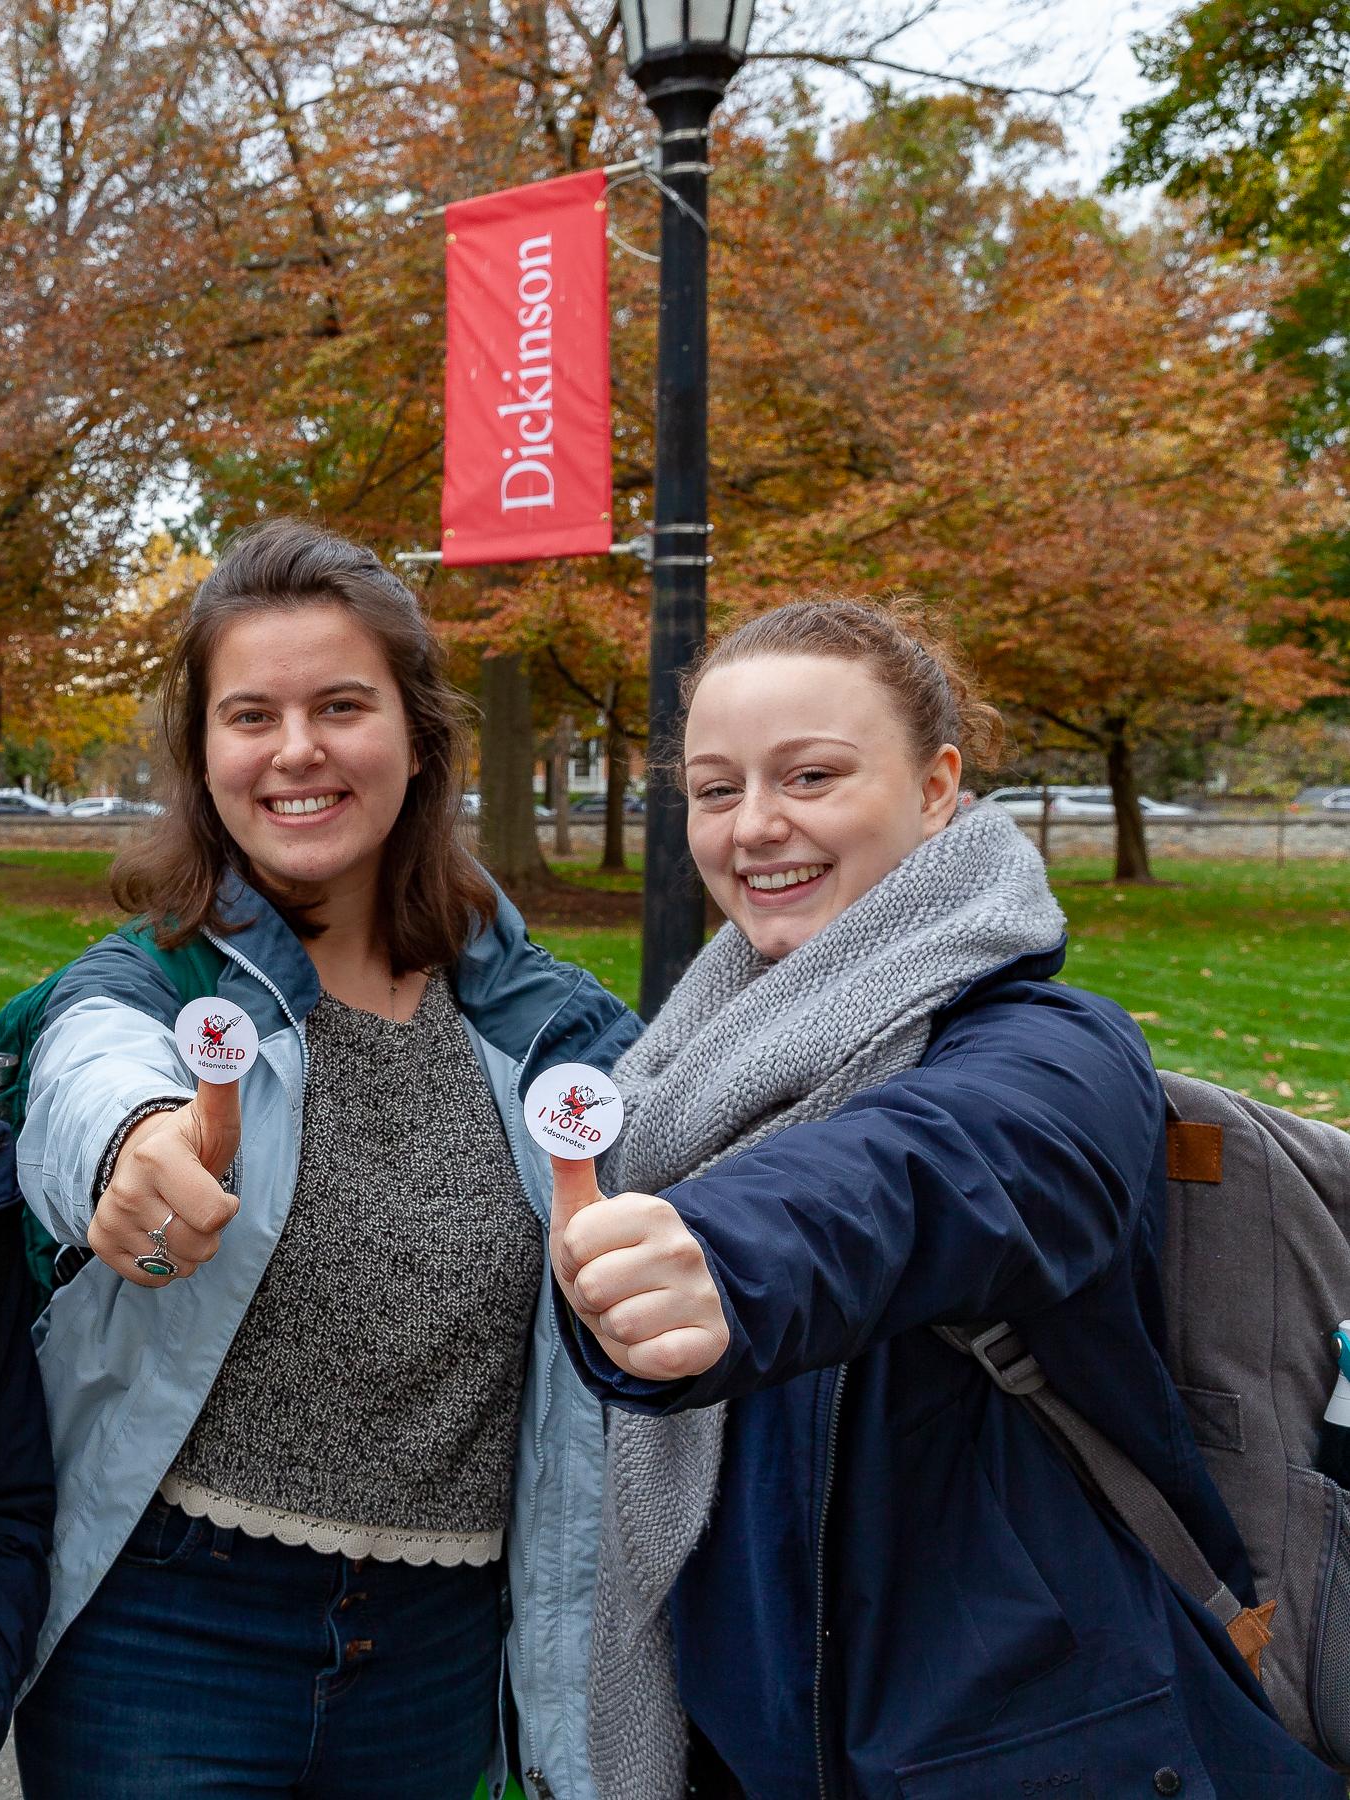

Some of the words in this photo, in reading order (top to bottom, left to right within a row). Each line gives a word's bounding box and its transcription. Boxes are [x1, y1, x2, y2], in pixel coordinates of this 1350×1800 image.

[497, 231, 555, 514] Dickinson
[190, 1043, 194, 1055] I
[198, 1044, 246, 1060] VOTED
[197, 1060, 238, 1070] #dsonvotes
[537, 1106, 547, 1118] I
[550, 1110, 601, 1143] VOTED
[542, 1125, 586, 1151] #dsonvotes
